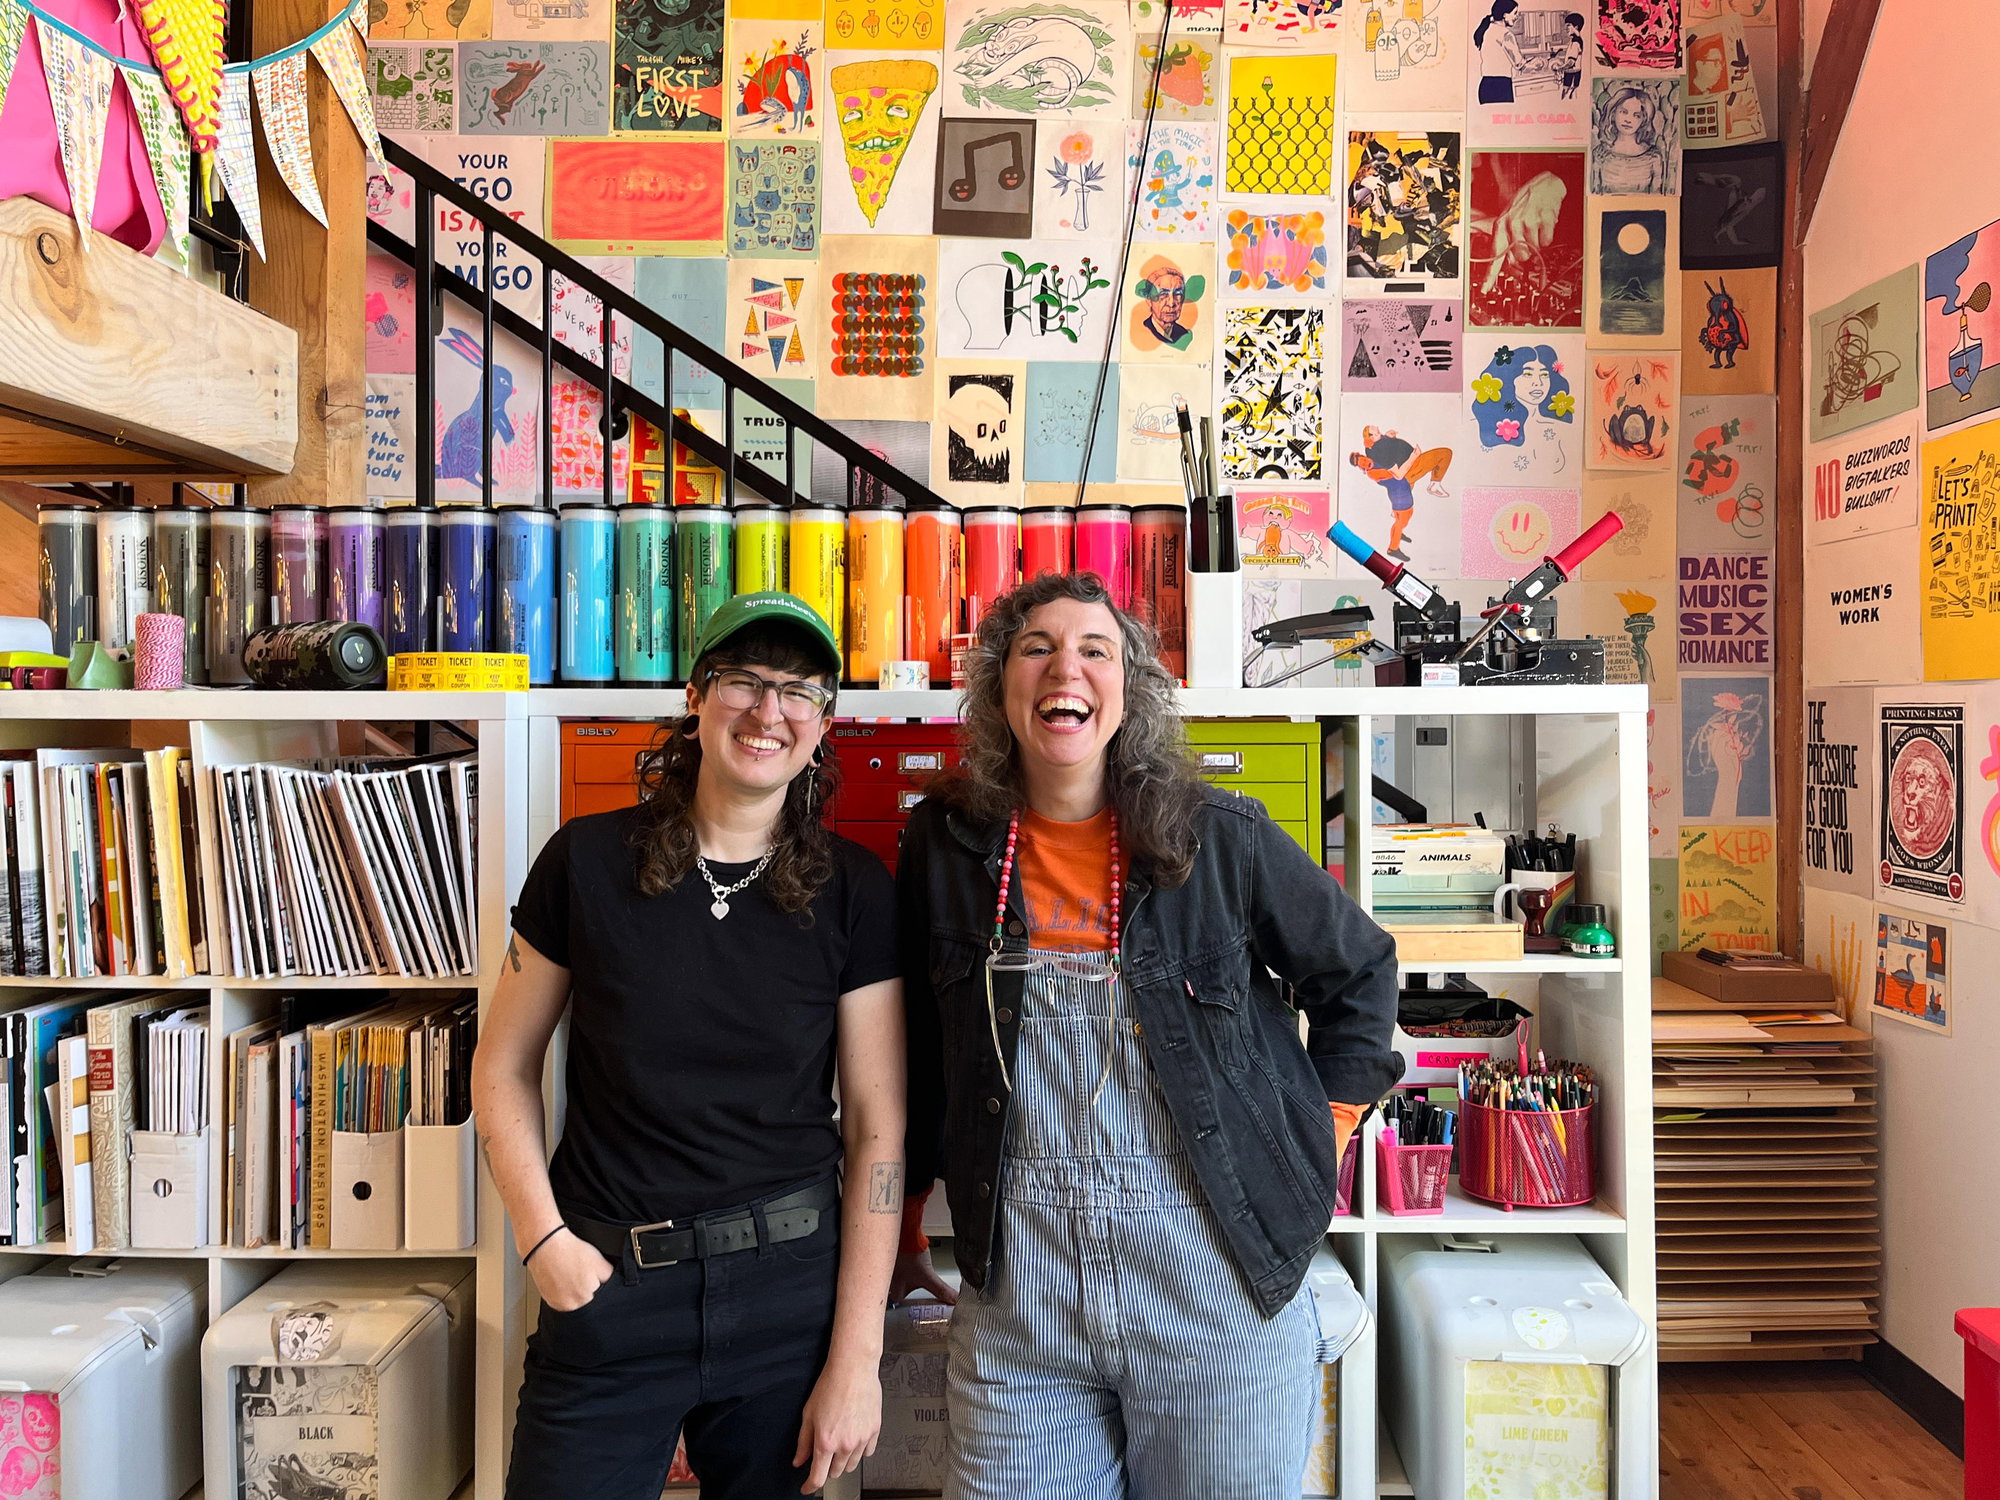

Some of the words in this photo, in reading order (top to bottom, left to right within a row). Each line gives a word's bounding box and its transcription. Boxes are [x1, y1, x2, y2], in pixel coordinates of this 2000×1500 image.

[636, 66, 704, 93] FIRST
[1515, 113, 1534, 125] LA
[1536, 113, 1576, 125] CASA
[1152, 128, 1169, 140] THE
[1174, 128, 1205, 147] MAGIC
[458, 154, 508, 169] YOUR
[440, 210, 463, 232] IS
[457, 242, 507, 257] YOR
[446, 265, 533, 290] MGO
[366, 395, 389, 404] am
[366, 407, 400, 419] part
[743, 417, 785, 427] TRUS
[1689, 405, 1710, 418] TRY!
[371, 431, 399, 446] the
[1736, 444, 1762, 453] TRY!
[368, 447, 405, 463] ture
[743, 451, 787, 461] EART
[1845, 435, 1911, 471] BUZZWORDS
[1845, 459, 1911, 492] BIGTALKERS
[1695, 490, 1719, 505] TRY!
[1815, 459, 1841, 522] NO
[1845, 485, 1900, 513] BULLSHIT!
[1938, 475, 1971, 501] LET'S
[137, 539, 148, 588] RISOINK
[256, 540, 265, 589] RISOINK
[661, 538, 670, 587] RISOINK
[702, 536, 712, 585] RISOINK
[1164, 537, 1175, 587] RISOINK
[1680, 556, 1768, 580] DANCE
[1680, 584, 1768, 608] MUSIC
[1831, 584, 1892, 606] WOMEN'S
[1680, 612, 1768, 635] SEX
[1840, 607, 1880, 625] WORK
[417, 657, 437, 666] TICKET
[449, 657, 472, 666] TICKET
[485, 658, 505, 666] TICKET
[1680, 640, 1769, 663] ROMANCE
[1808, 701, 1826, 742] THE
[1886, 709, 1926, 718] PRINTING
[1927, 709, 1936, 718] IS
[1937, 709, 1959, 718] EASY
[577, 727, 618, 736] BISLEY
[835, 729, 877, 737] BISLEY
[1900, 727, 1931, 745] NOTHING
[1932, 732, 1950, 754] EVER
[1807, 743, 1858, 789] PRESSURE
[1806, 785, 1816, 826] IS
[1819, 787, 1848, 831] GOOD
[1419, 854, 1471, 862] ANIMALS
[1713, 829, 1773, 865] KEEP
[1806, 827, 1827, 870] FOR
[1831, 830, 1853, 875] YOU
[1896, 845, 1915, 866] GOES
[1917, 853, 1944, 870] WRONG
[1681, 890, 1710, 918] IN
[1428, 1054, 1476, 1065] CRAY
[317, 1053, 326, 1146] WASHINGTON
[317, 1155, 326, 1188] LENS
[316, 1197, 325, 1229] 1965
[299, 1426, 334, 1440] BLACK
[1502, 1427, 1528, 1440] LIME
[1532, 1428, 1568, 1442] GREEN
